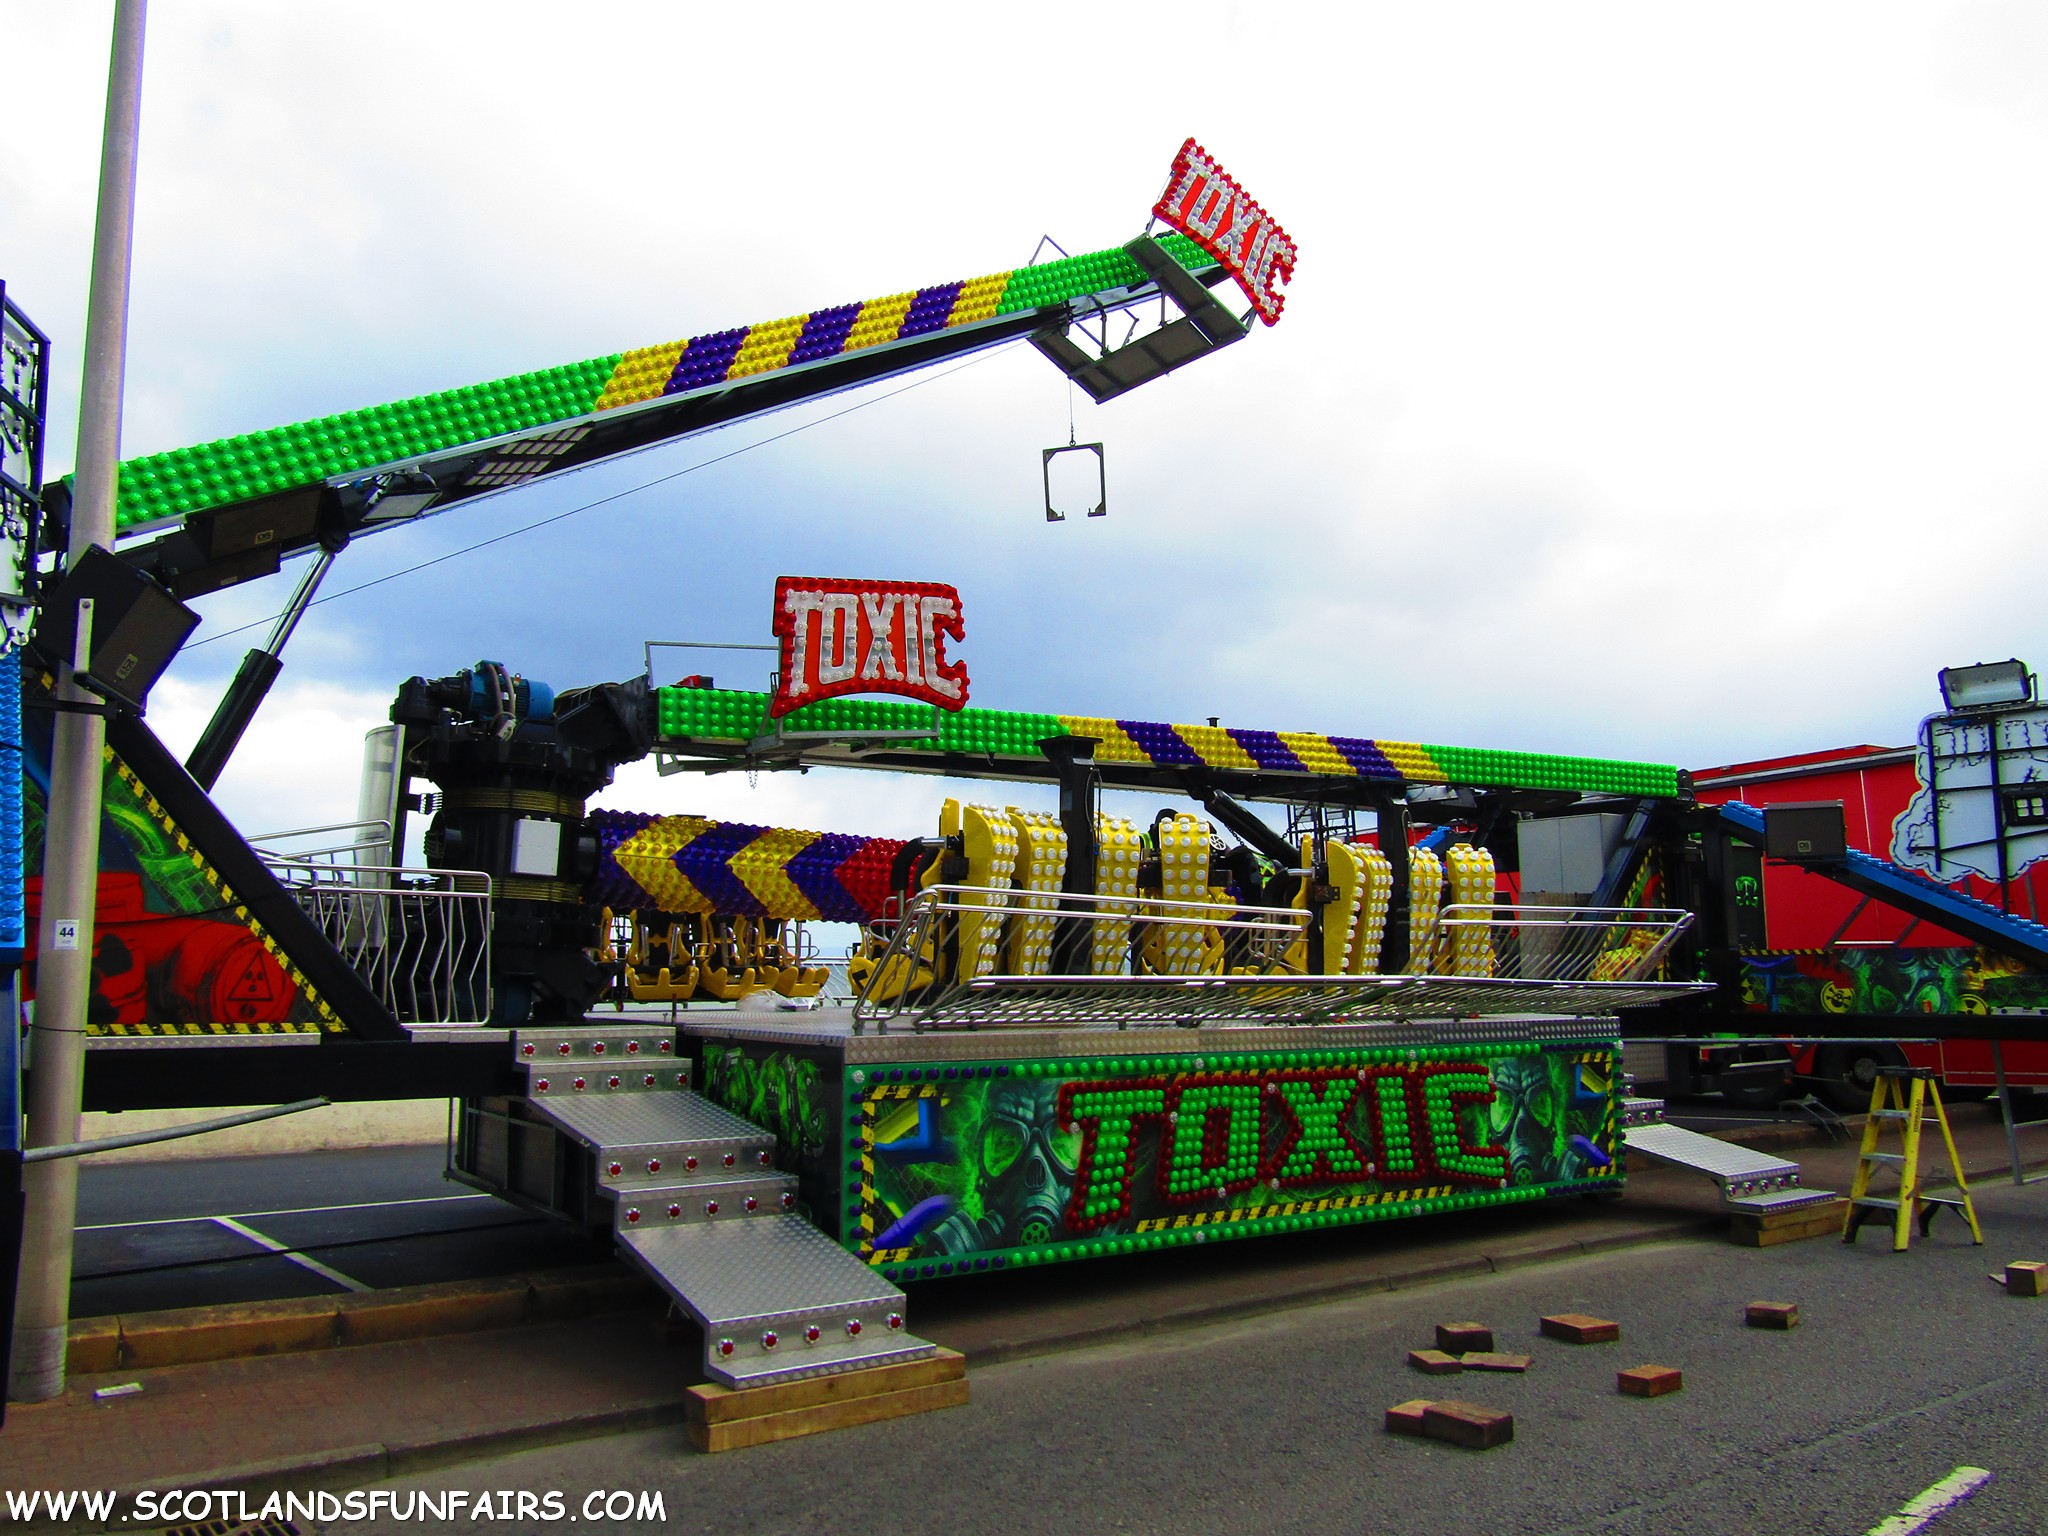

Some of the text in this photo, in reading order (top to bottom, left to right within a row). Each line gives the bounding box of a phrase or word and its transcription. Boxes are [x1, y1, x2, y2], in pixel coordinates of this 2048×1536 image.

[1166, 146, 1293, 316] TOXIC
[785, 588, 963, 700] TOXIC
[60, 927, 75, 938] 44
[1058, 1065, 1509, 1231] TOXIC
